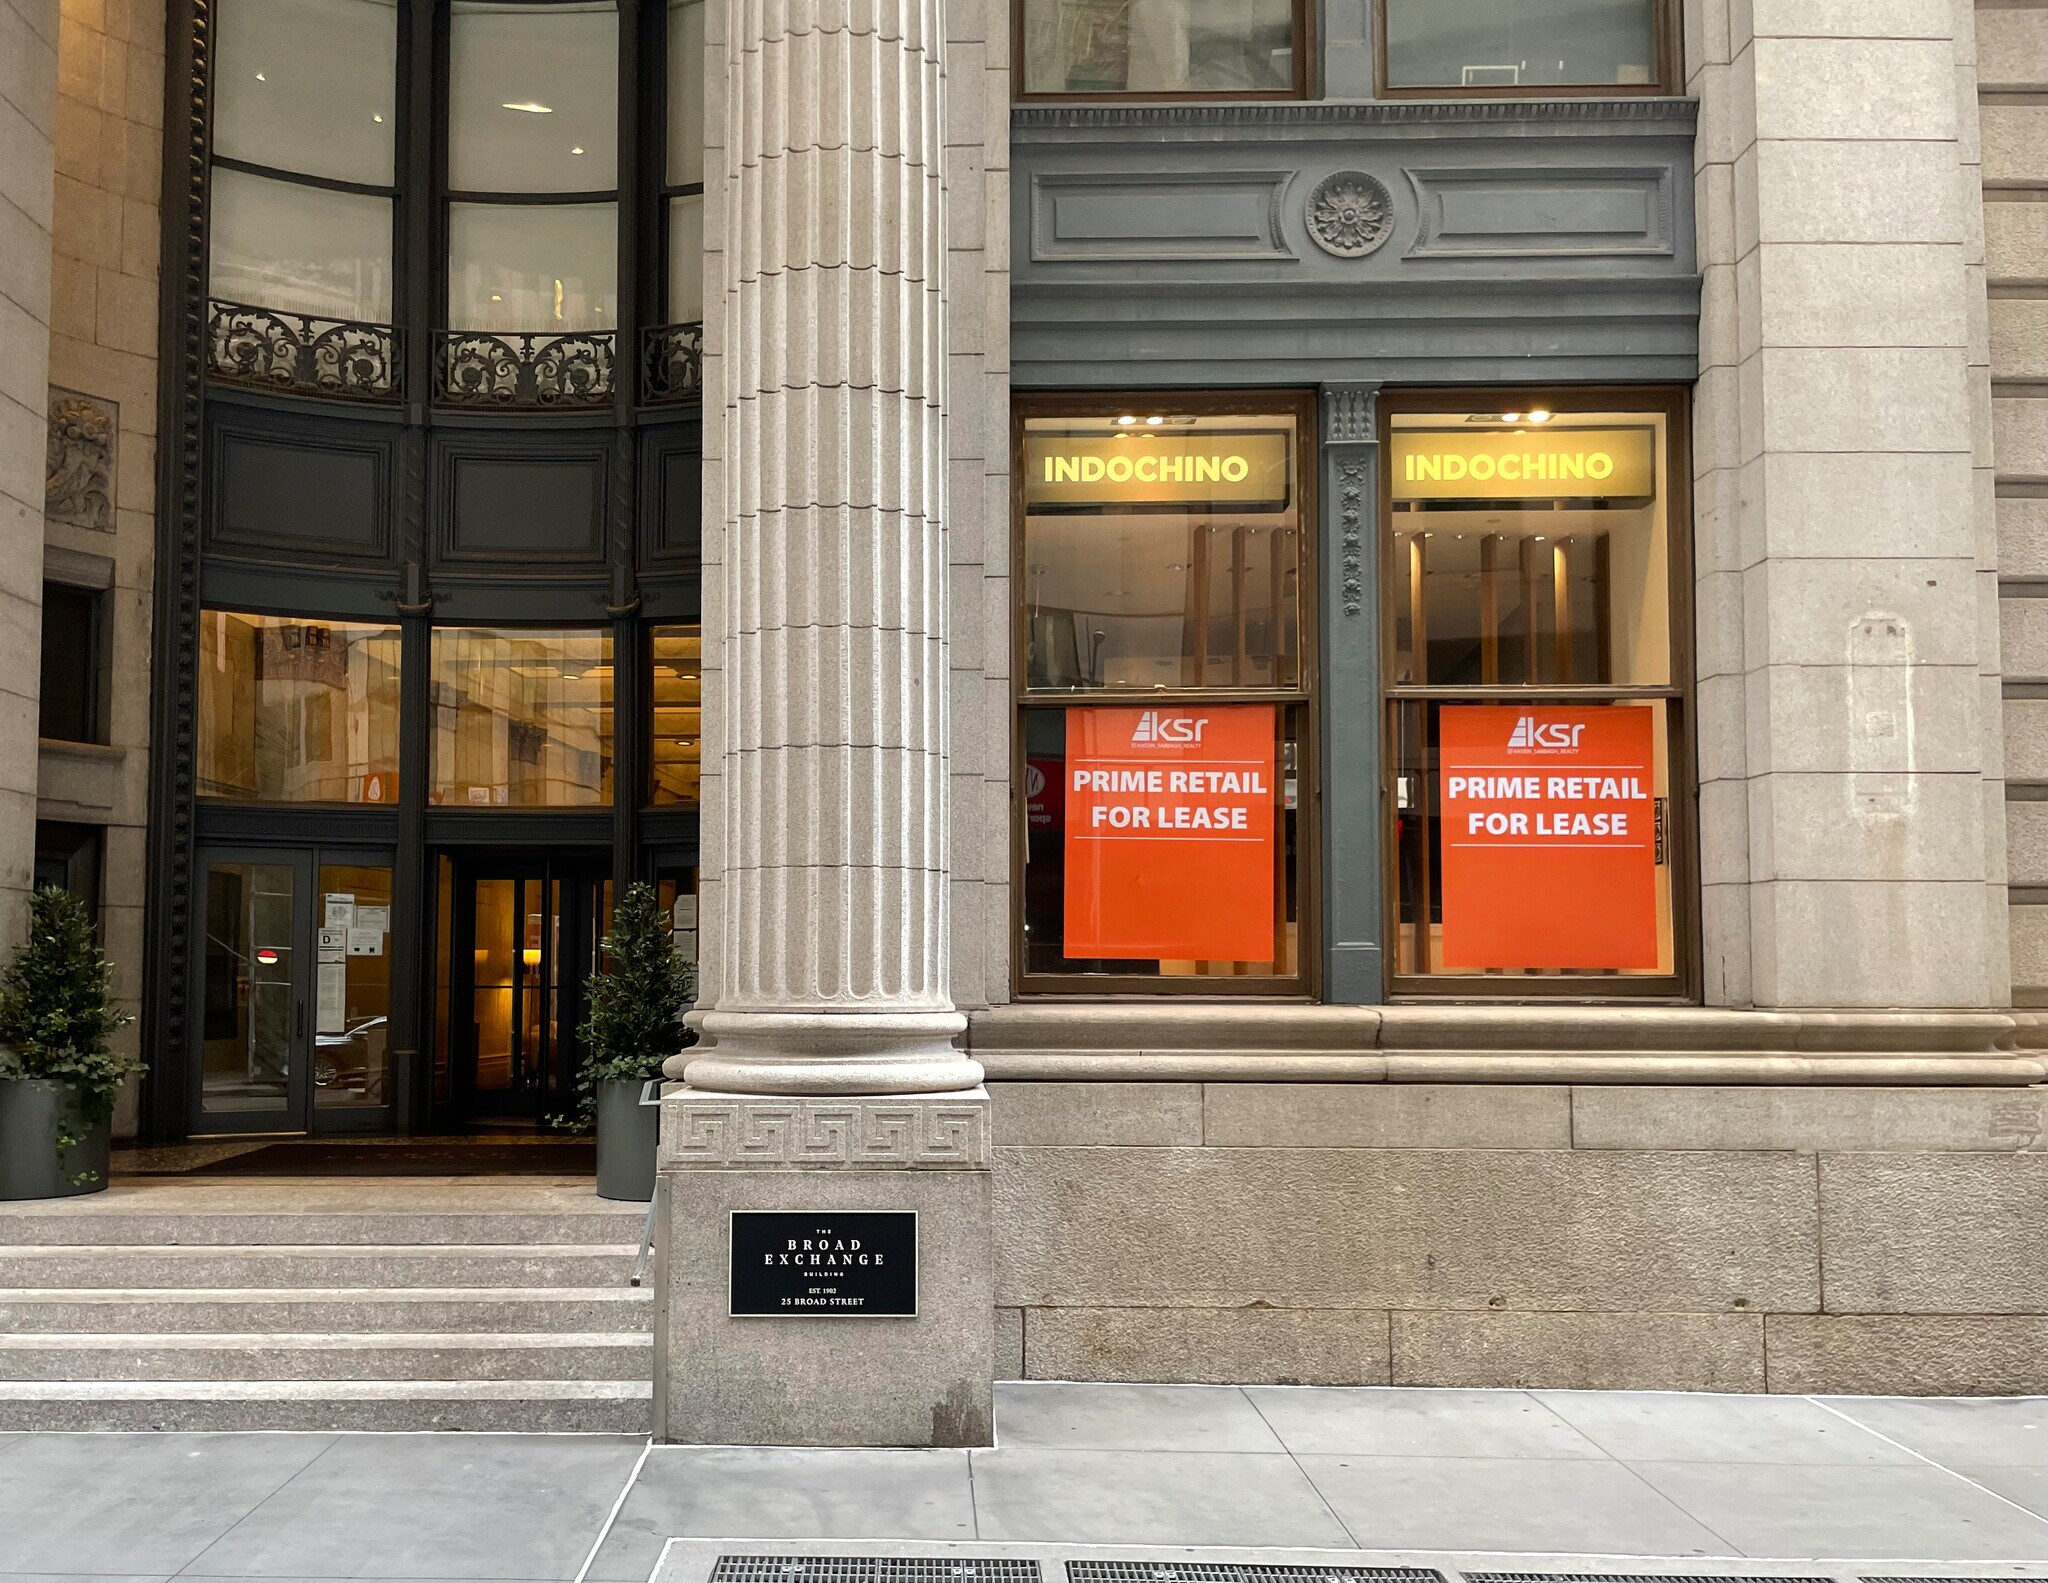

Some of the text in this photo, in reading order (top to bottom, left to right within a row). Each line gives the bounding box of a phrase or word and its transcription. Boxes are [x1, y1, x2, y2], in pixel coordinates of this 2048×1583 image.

[1043, 455, 1249, 484] INDOCHINO
[1404, 452, 1614, 481] INDOCHINO
[1151, 711, 1209, 742] ksr
[1527, 716, 1586, 747] ksr
[1073, 769, 1163, 793] PRIME
[1170, 770, 1267, 795] RETAIL
[1448, 776, 1647, 801] PRIME RETAIL
[1092, 806, 1247, 830] FOR LEASE
[1468, 812, 1628, 836] FOR LEASE
[787, 1239, 862, 1251] BROAD
[764, 1254, 884, 1265] EXCHANGE
[781, 1298, 865, 1306] 25 BROAD STREET
